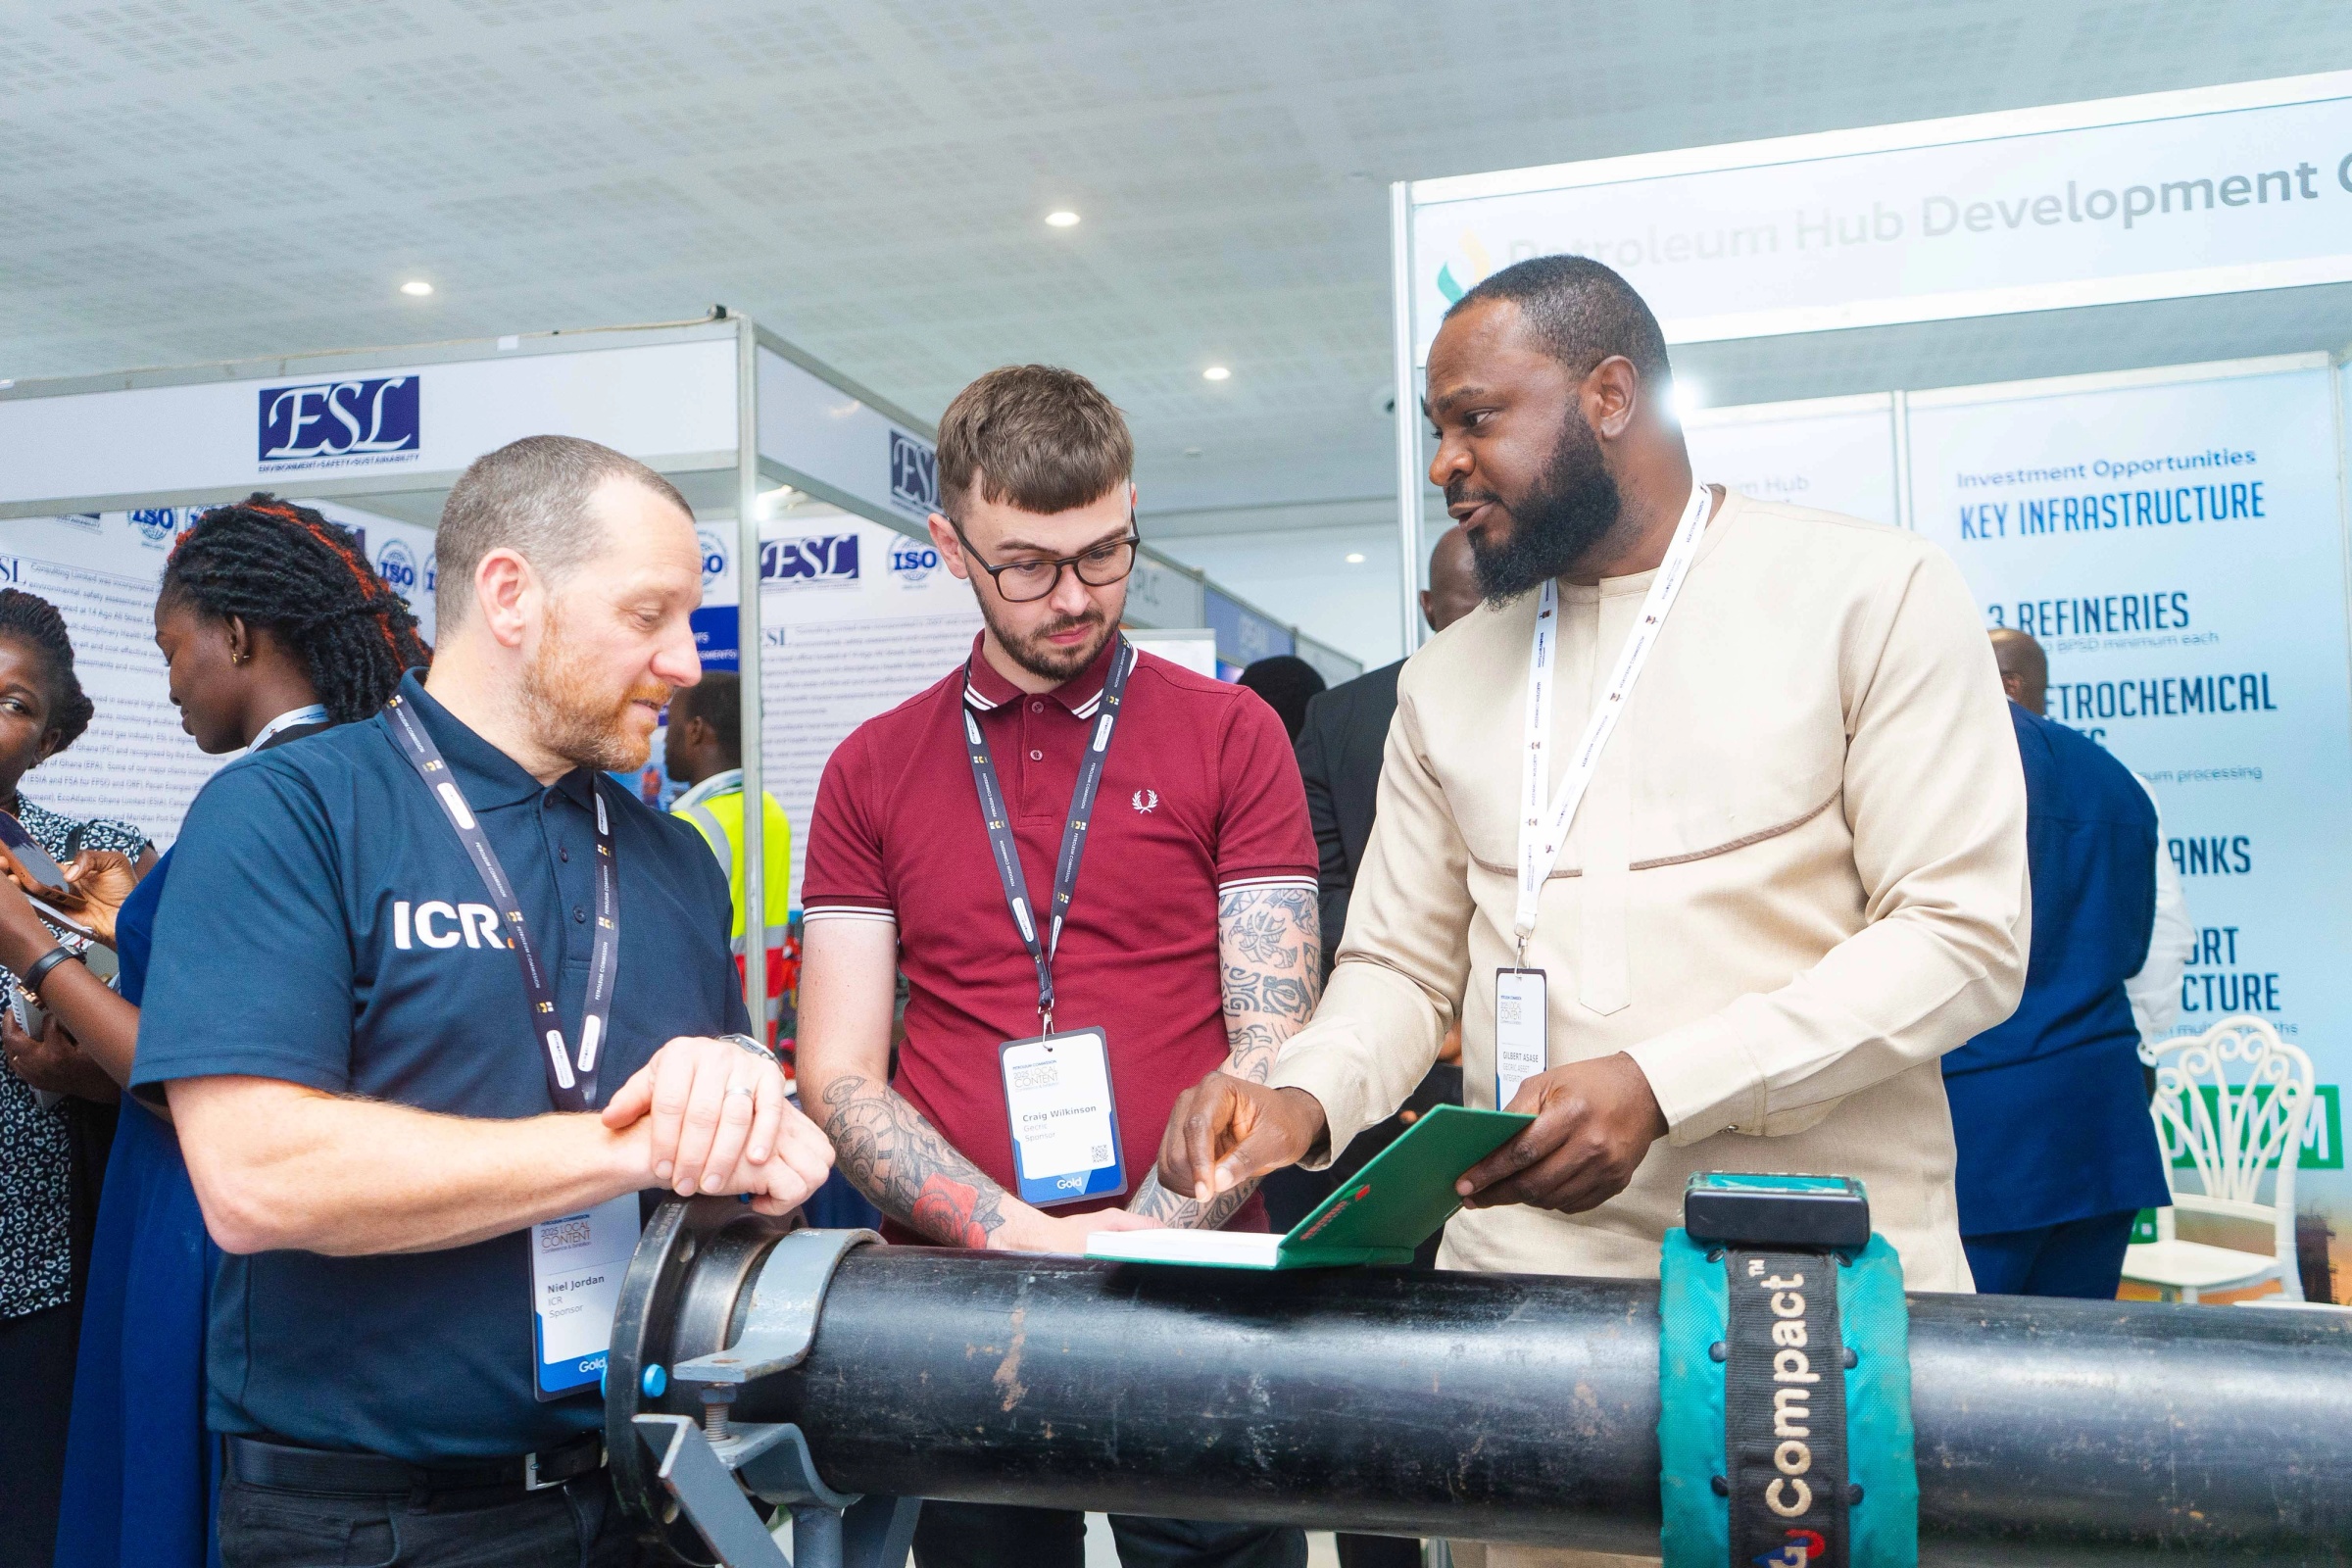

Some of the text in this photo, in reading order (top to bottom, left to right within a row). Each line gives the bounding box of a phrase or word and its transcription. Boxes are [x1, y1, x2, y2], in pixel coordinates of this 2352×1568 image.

[1796, 201, 1903, 251] Hub
[1922, 161, 2319, 239] Development
[264, 376, 412, 459] ESL
[1957, 448, 2257, 489] Investment Opportunities
[1960, 481, 2266, 540] KEY INFRASTRUCTURE
[760, 534, 856, 582] ESL
[894, 550, 937, 570] ISO
[380, 561, 414, 586] ISO
[2019, 592, 2190, 638] REFINERIES
[2182, 632, 2220, 646] each
[2045, 672, 2278, 722] ETROCHEMICAL
[2178, 765, 2263, 784] processing
[2167, 835, 2252, 875] ANKS
[488, 865, 508, 898] COMMISSION
[515, 925, 541, 989] PETROLEUM COMMISSION
[594, 941, 609, 1001] PETROLEUM COMMISSION
[1503, 1051, 1539, 1062] GILBERT ASASE
[1014, 1072, 1058, 1088] CONTENT
[1022, 1105, 1097, 1121] Craig Wilkinson
[1024, 1132, 1055, 1143] Sponsor
[1056, 1176, 1083, 1190] Gold
[540, 1221, 590, 1238] 2025 LOCAL
[542, 1230, 591, 1249] CONTENT
[547, 1276, 605, 1295] Niel Jordan
[548, 1296, 564, 1306] ICR
[550, 1304, 584, 1319] Sponsor
[578, 1356, 607, 1373] Gold
[1761, 1274, 1821, 1518] Compact
